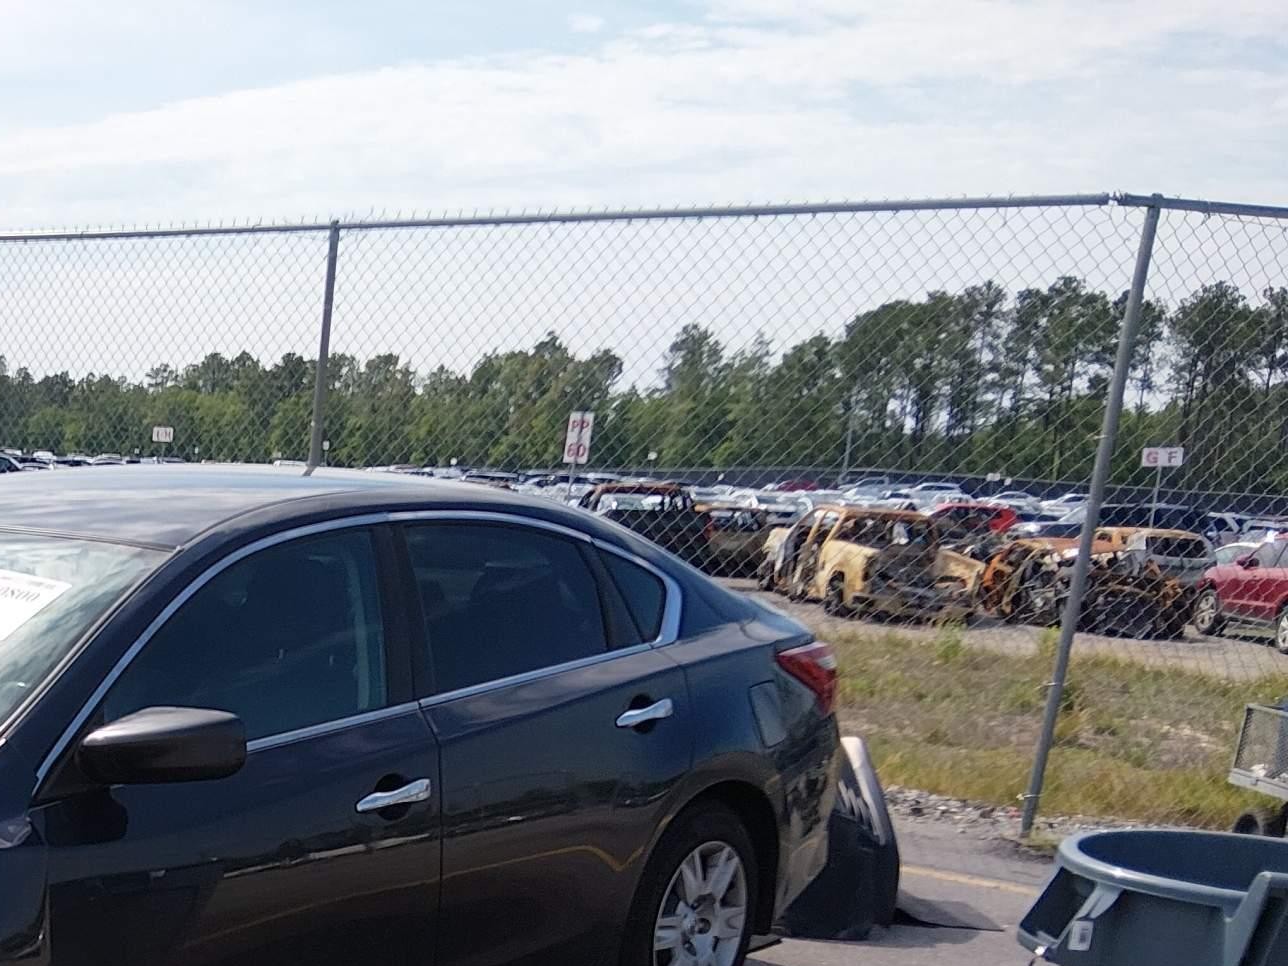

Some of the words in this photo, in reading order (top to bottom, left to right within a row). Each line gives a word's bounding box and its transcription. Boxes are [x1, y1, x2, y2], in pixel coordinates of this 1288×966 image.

[567, 442, 587, 457] 60
[1145, 450, 1159, 464] G
[1167, 450, 1178, 463] F
